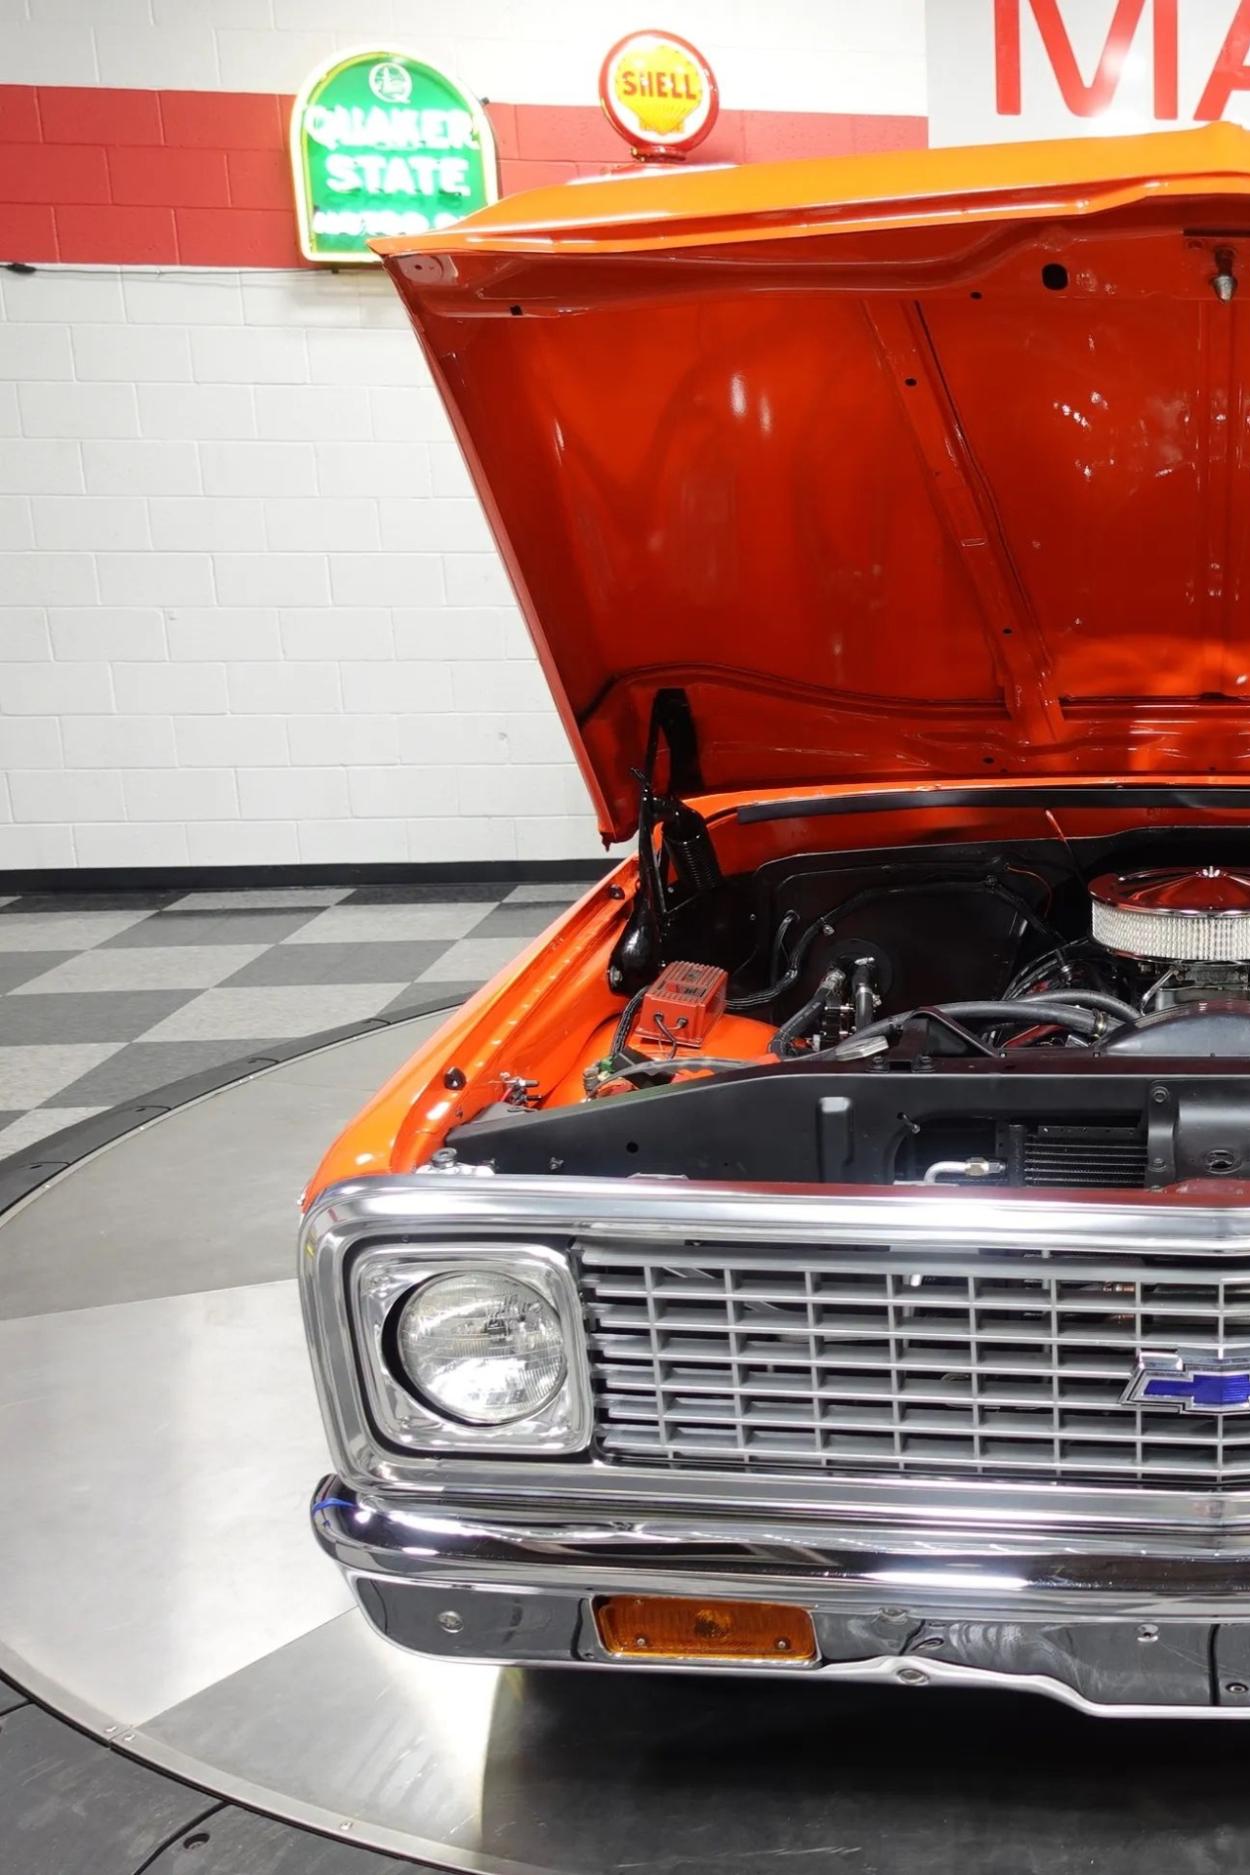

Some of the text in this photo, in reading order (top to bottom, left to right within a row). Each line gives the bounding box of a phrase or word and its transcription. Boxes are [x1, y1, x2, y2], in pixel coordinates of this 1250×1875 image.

[622, 70, 697, 100] SHELL
[304, 105, 481, 151] QUAKER
[325, 153, 471, 196] STATE
